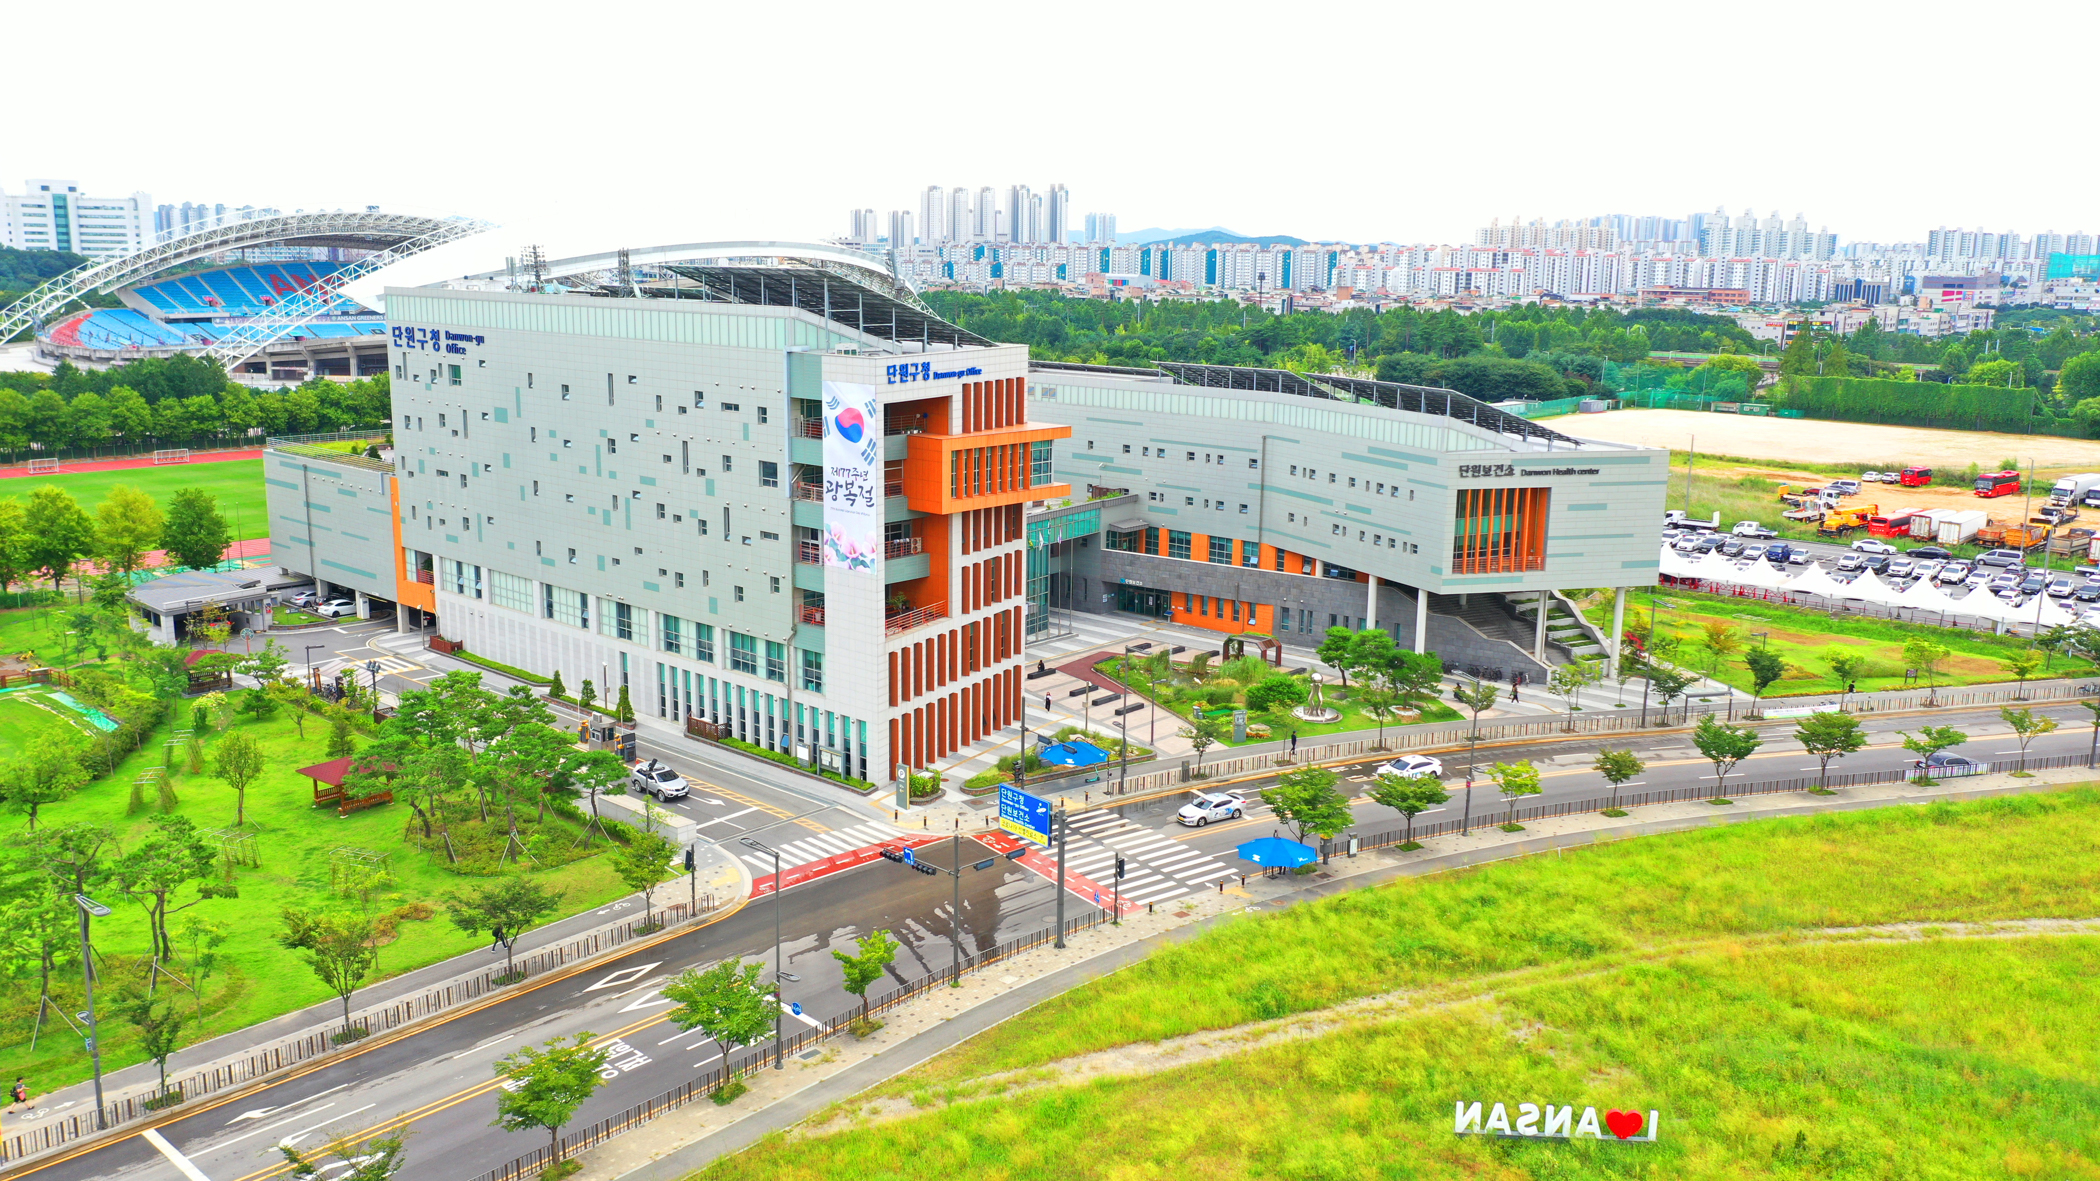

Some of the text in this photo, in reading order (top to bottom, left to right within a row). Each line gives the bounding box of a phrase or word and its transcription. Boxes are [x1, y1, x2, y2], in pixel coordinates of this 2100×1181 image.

[391, 326, 440, 352] 단원구청
[445, 330, 485, 346] Danwon-gu
[446, 343, 467, 355] Office
[887, 361, 983, 384] 단원구청 Danwon-gu Office
[830, 466, 869, 482] 제77주년
[1459, 464, 1515, 478] 단원보건소
[1520, 469, 1551, 477] Danwon
[1552, 467, 1576, 476] Health
[825, 479, 875, 508] 광복절
[1001, 788, 1025, 805] 단원구청
[1001, 804, 1030, 823] 단원보건소
